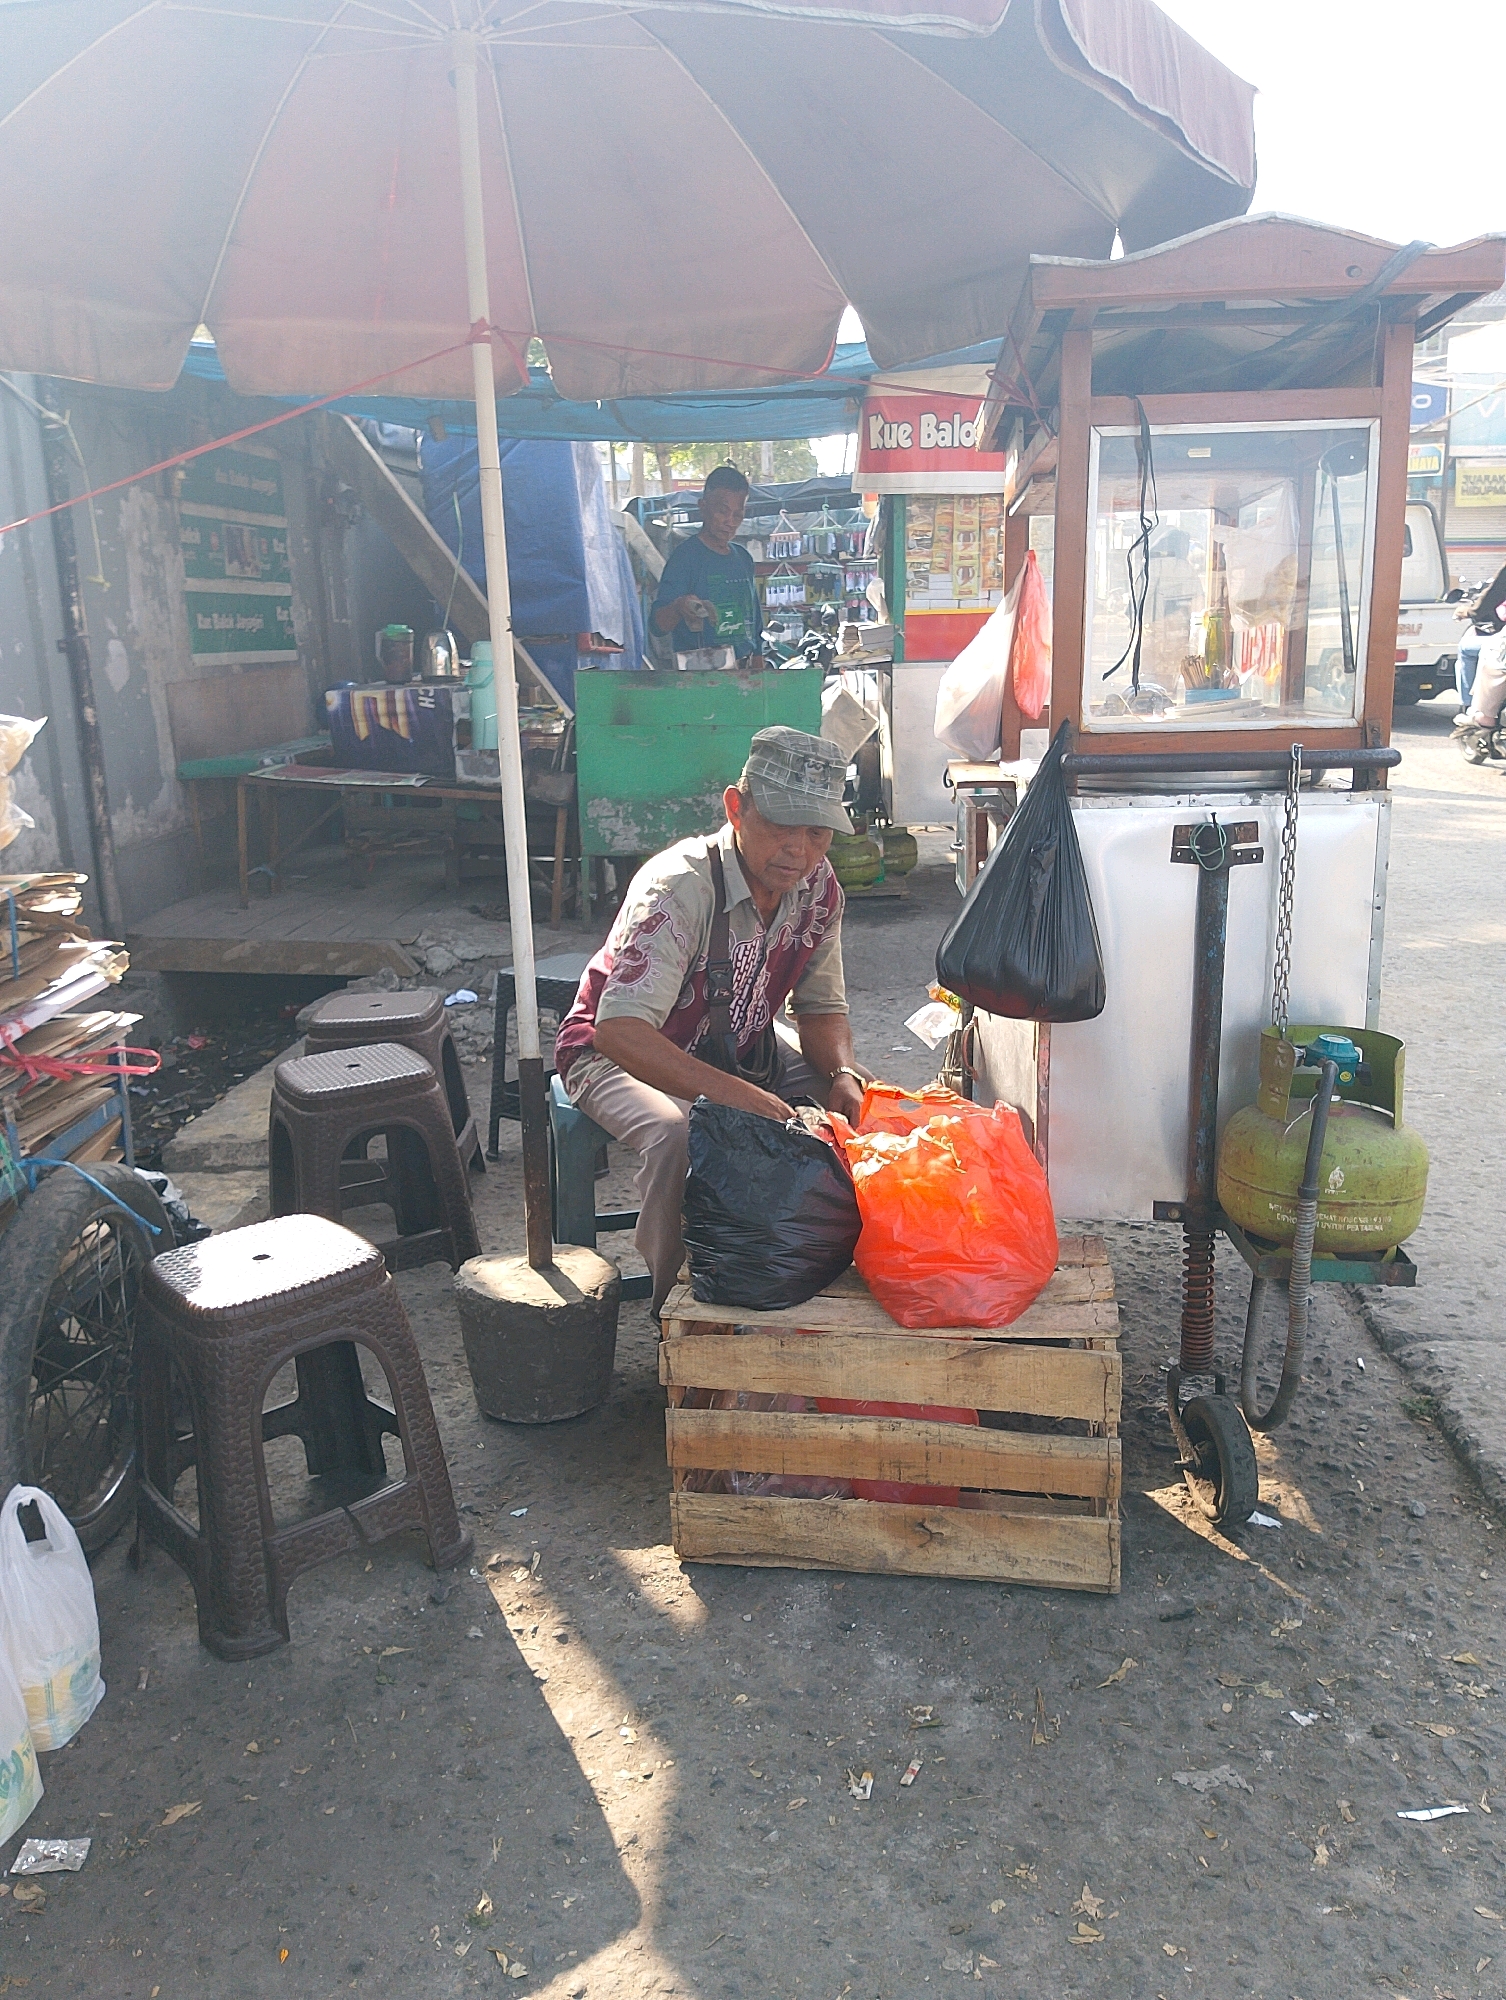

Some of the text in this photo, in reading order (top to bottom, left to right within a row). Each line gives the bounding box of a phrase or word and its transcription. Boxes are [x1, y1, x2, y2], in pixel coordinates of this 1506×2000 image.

[1476, 396, 1506, 418] V
[868, 412, 977, 450] Kue Balo
